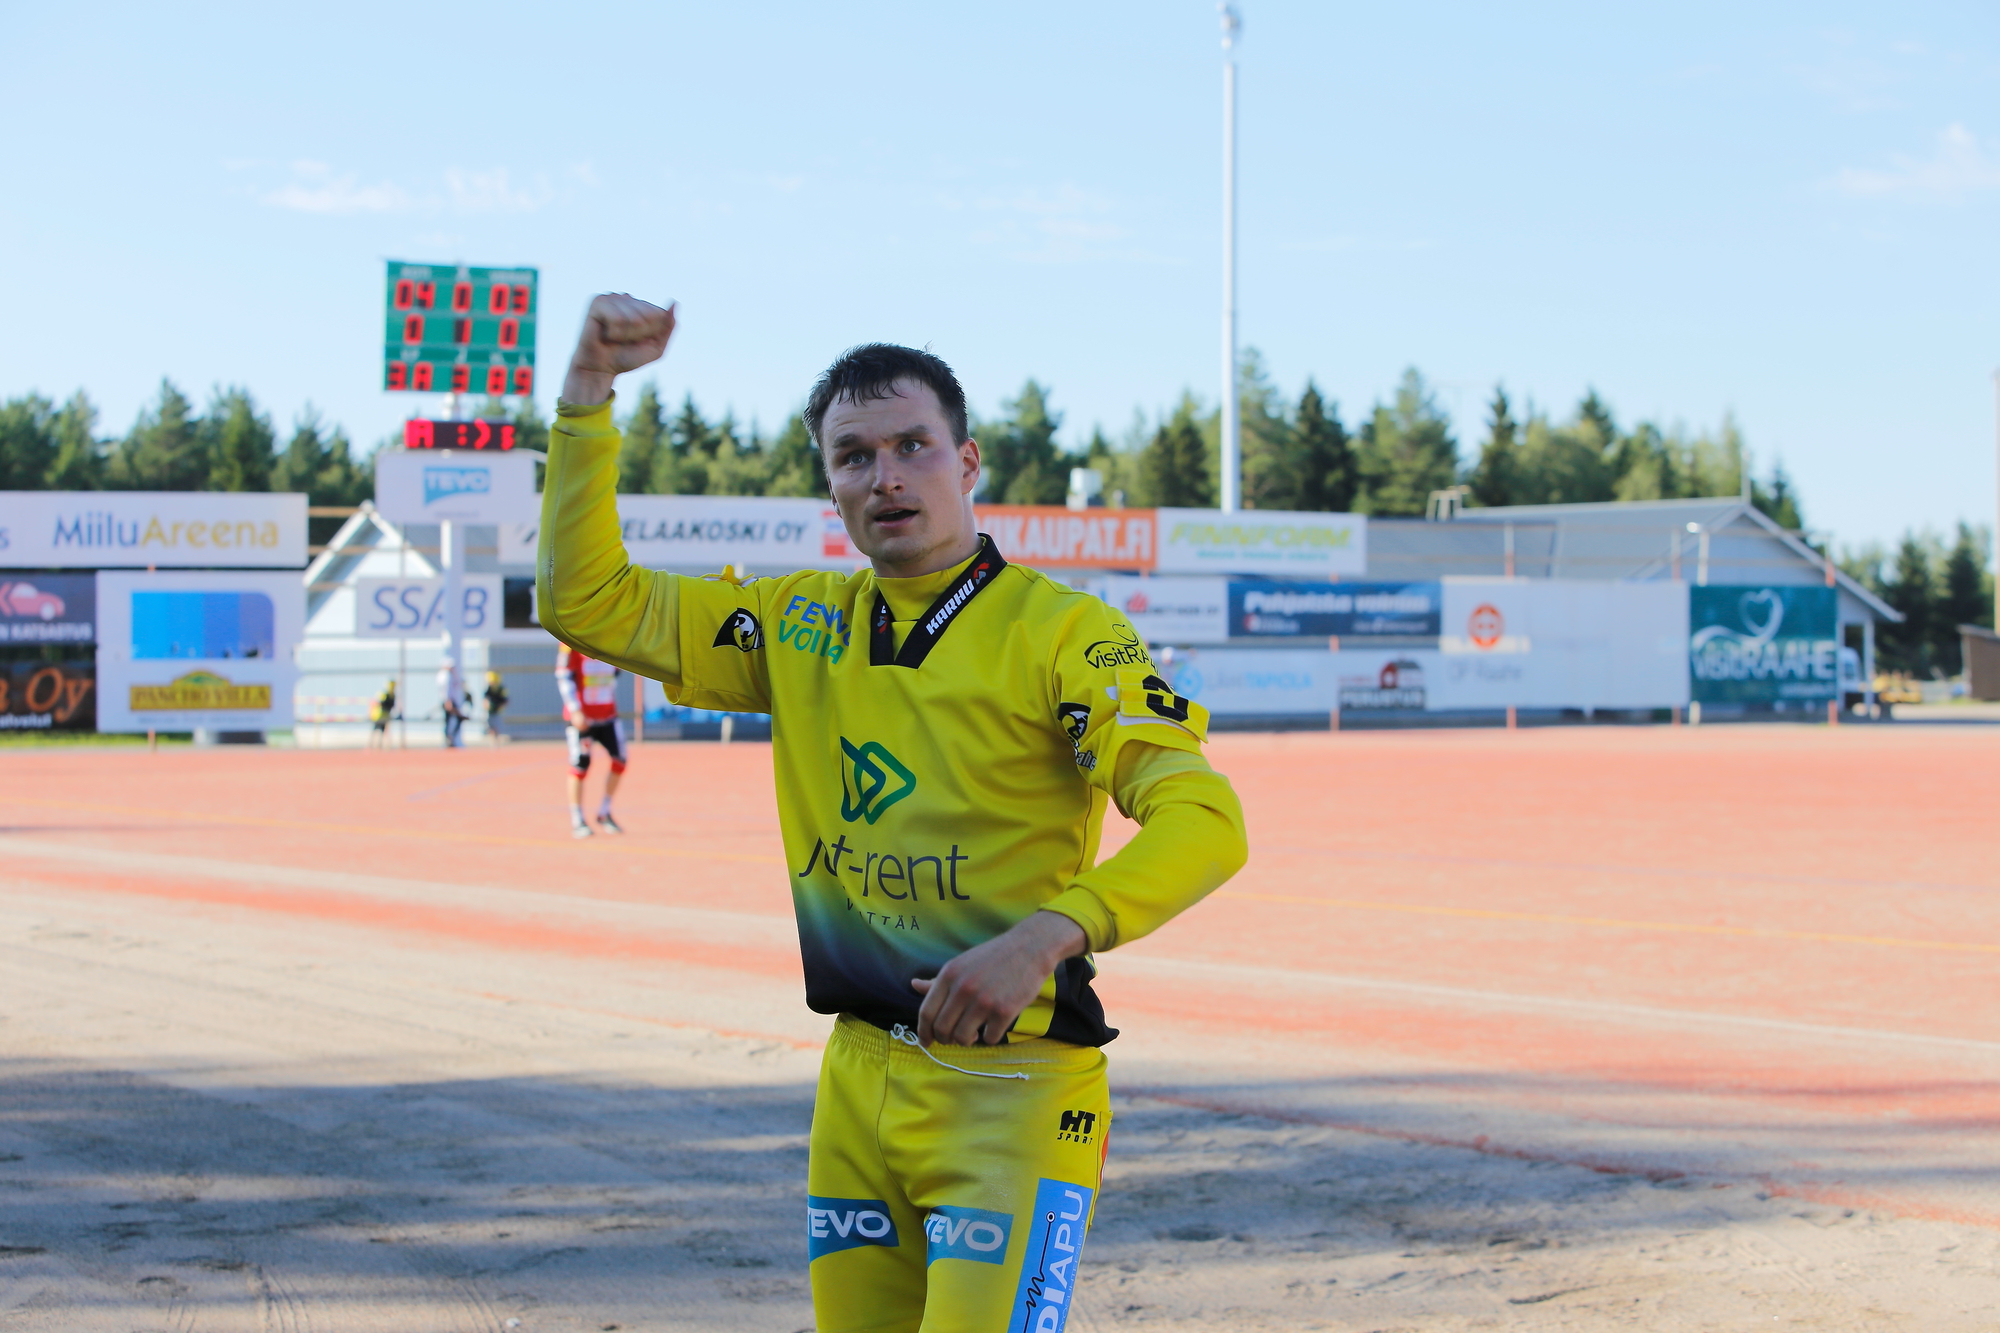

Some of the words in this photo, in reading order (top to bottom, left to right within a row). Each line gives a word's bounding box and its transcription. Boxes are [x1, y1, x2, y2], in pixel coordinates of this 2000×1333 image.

[394, 279, 436, 311] 04
[489, 283, 530, 316] 03
[428, 472, 489, 491] TEVO
[53, 512, 279, 548] MiiluAreena
[622, 518, 768, 542] ELAAKOSKI
[775, 521, 809, 543] OY
[926, 578, 975, 635] KARHU
[26, 667, 94, 723] Oy
[1060, 1110, 1096, 1134] HT
[925, 1213, 1004, 1252] TEVO
